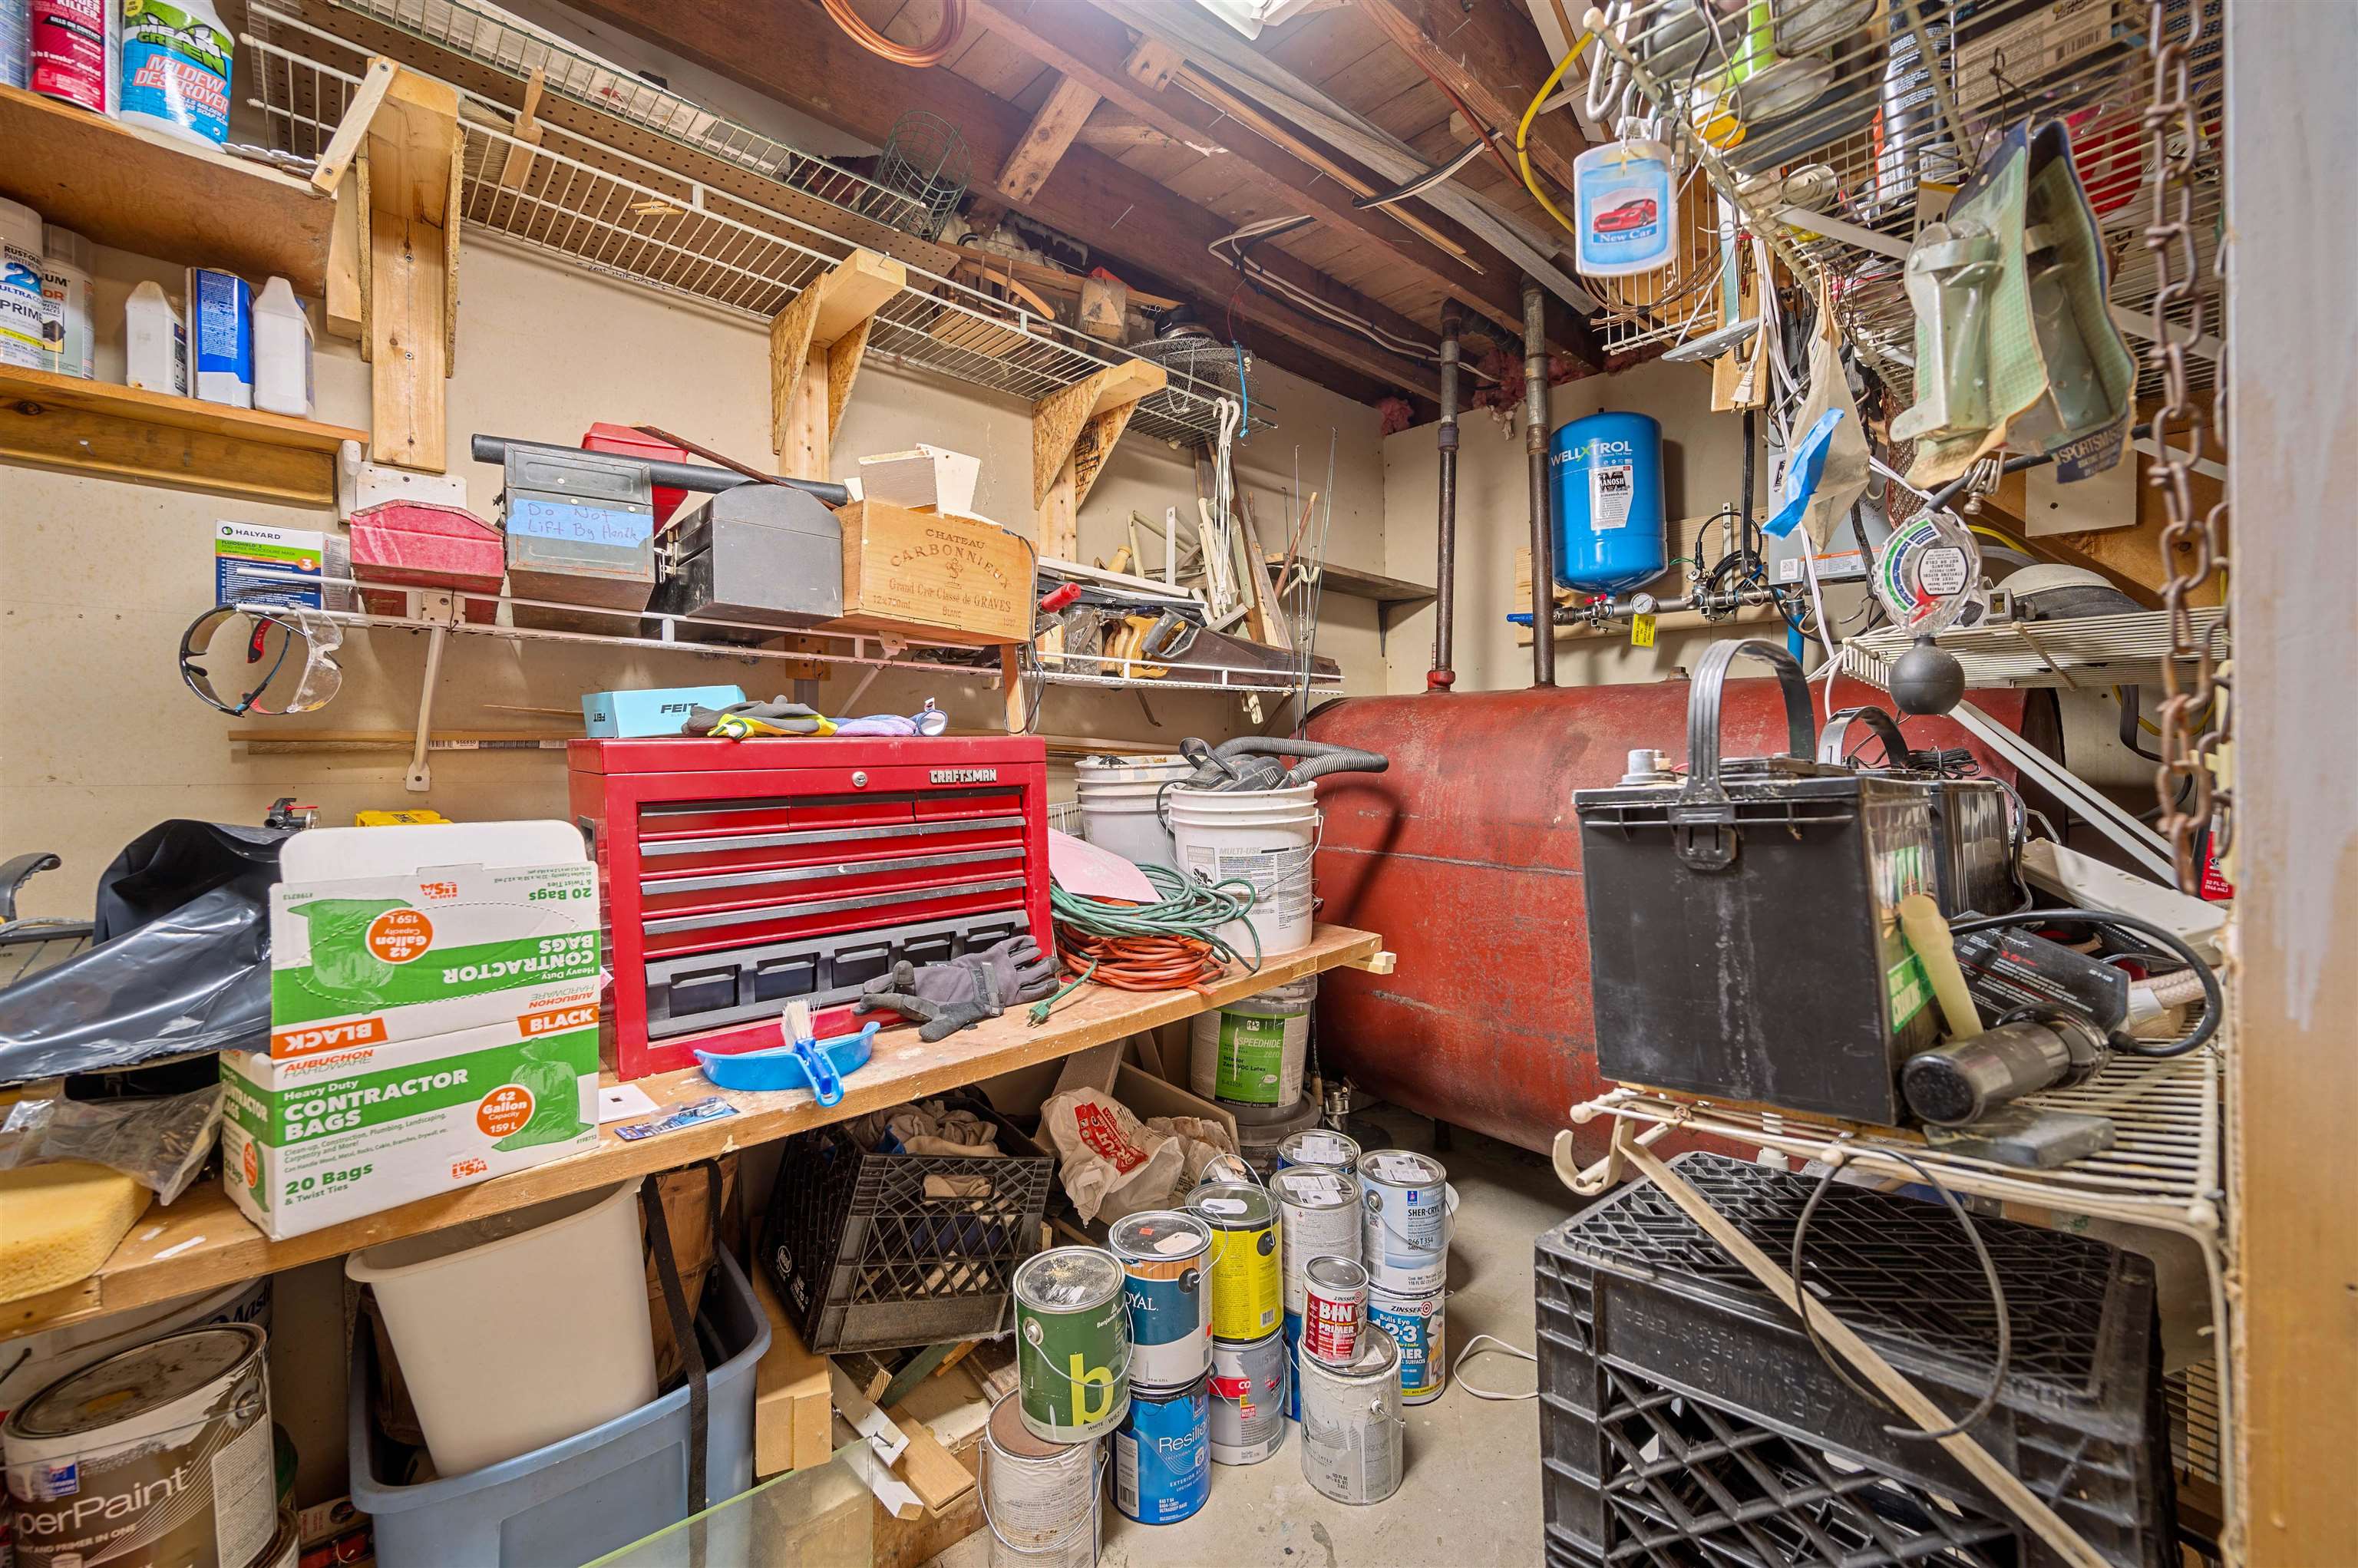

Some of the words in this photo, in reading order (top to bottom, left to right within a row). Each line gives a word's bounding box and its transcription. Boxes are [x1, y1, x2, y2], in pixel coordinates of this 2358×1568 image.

[140, 24, 221, 58] MEAN
[137, 31, 228, 81] GREEN
[148, 56, 226, 91] MILDEW
[135, 70, 229, 113] DESTROYER
[1600, 233, 1628, 243] New
[1628, 229, 1653, 239] Car
[527, 503, 554, 517] Do
[574, 507, 616, 523] Not
[236, 529, 281, 540] HALYARD
[527, 519, 565, 536] Lift
[572, 522, 596, 541] By
[926, 528, 986, 550] CHATEAU
[302, 559, 313, 569] 3
[890, 544, 1012, 591] CARBONNIEUX
[889, 579, 916, 596] Grand
[973, 595, 1012, 613] GRAVES
[661, 702, 699, 715] FEIT
[593, 713, 606, 723] FEIT
[930, 768, 997, 784] CRAFTSMAN
[1219, 847, 1261, 855] MULTI-USE
[528, 888, 567, 900] Bags
[572, 888, 592, 899] 20
[397, 914, 418, 924] 159
[384, 927, 421, 936] Capacity
[375, 936, 427, 946] Gallon
[539, 934, 594, 954] BAGS
[390, 946, 411, 958] 42
[442, 951, 595, 984] CONTRACTOR
[541, 970, 564, 980] Duty
[566, 966, 594, 977] Heavy
[529, 991, 593, 1009] AUBUCHON
[531, 984, 595, 1001] HARDWARE
[530, 1008, 594, 1032] BLACK
[285, 1023, 372, 1051] BLACK
[1239, 1036, 1282, 1048] SPEEDHIDE
[284, 1049, 374, 1073] AUBUCHON
[283, 1086, 326, 1101] Heavy
[328, 1080, 359, 1094] Duty
[283, 1068, 468, 1121] CONTRACTOR
[497, 1091, 516, 1102] 42
[482, 1101, 528, 1115] Gallon
[488, 1111, 520, 1121] Capacity
[285, 1109, 362, 1142] BAGS
[490, 1123, 510, 1134] 159
[510, 1122, 518, 1131] L
[321, 1132, 368, 1149] Construction,
[284, 1150, 321, 1164] Carpentry
[322, 1147, 337, 1156] and
[451, 1160, 488, 1179] USA
[285, 1177, 315, 1196] 20
[322, 1162, 374, 1186] Bags
[285, 1198, 293, 1207] &
[296, 1190, 325, 1203] Twist
[327, 1183, 348, 1194] Ties
[1408, 1206, 1439, 1217] SHER-CRYL
[1391, 1305, 1422, 1313] ZINSSER
[1319, 1322, 1355, 1334] PRIMER
[1379, 1314, 1395, 1325] Bulls
[1397, 1318, 1411, 1326] Eye
[1069, 1352, 1115, 1428] b
[1087, 1421, 1104, 1431] WHITE
[35, 1546, 54, 1554] AND
[56, 1537, 94, 1552] PRIMER
[94, 1534, 108, 1543] IN
[110, 1523, 137, 1538] ONE
